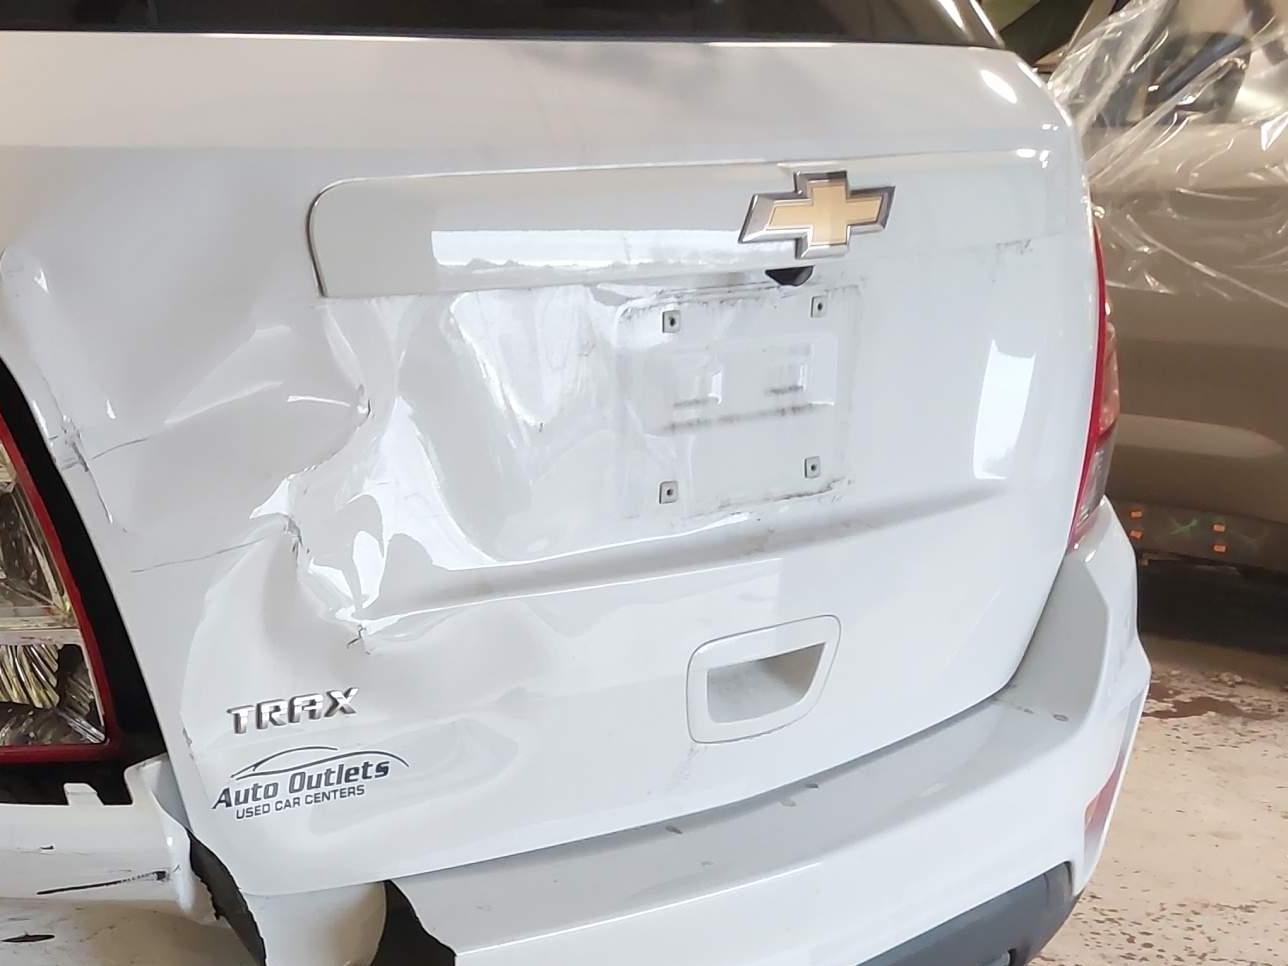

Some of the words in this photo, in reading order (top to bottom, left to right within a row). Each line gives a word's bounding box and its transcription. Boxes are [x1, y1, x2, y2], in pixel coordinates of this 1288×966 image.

[227, 687, 359, 734] TRAX
[212, 781, 279, 810] Auto
[288, 760, 390, 794] Outlets
[236, 803, 270, 820] USED
[275, 797, 301, 812] CAR
[305, 785, 365, 805] CENTERS
